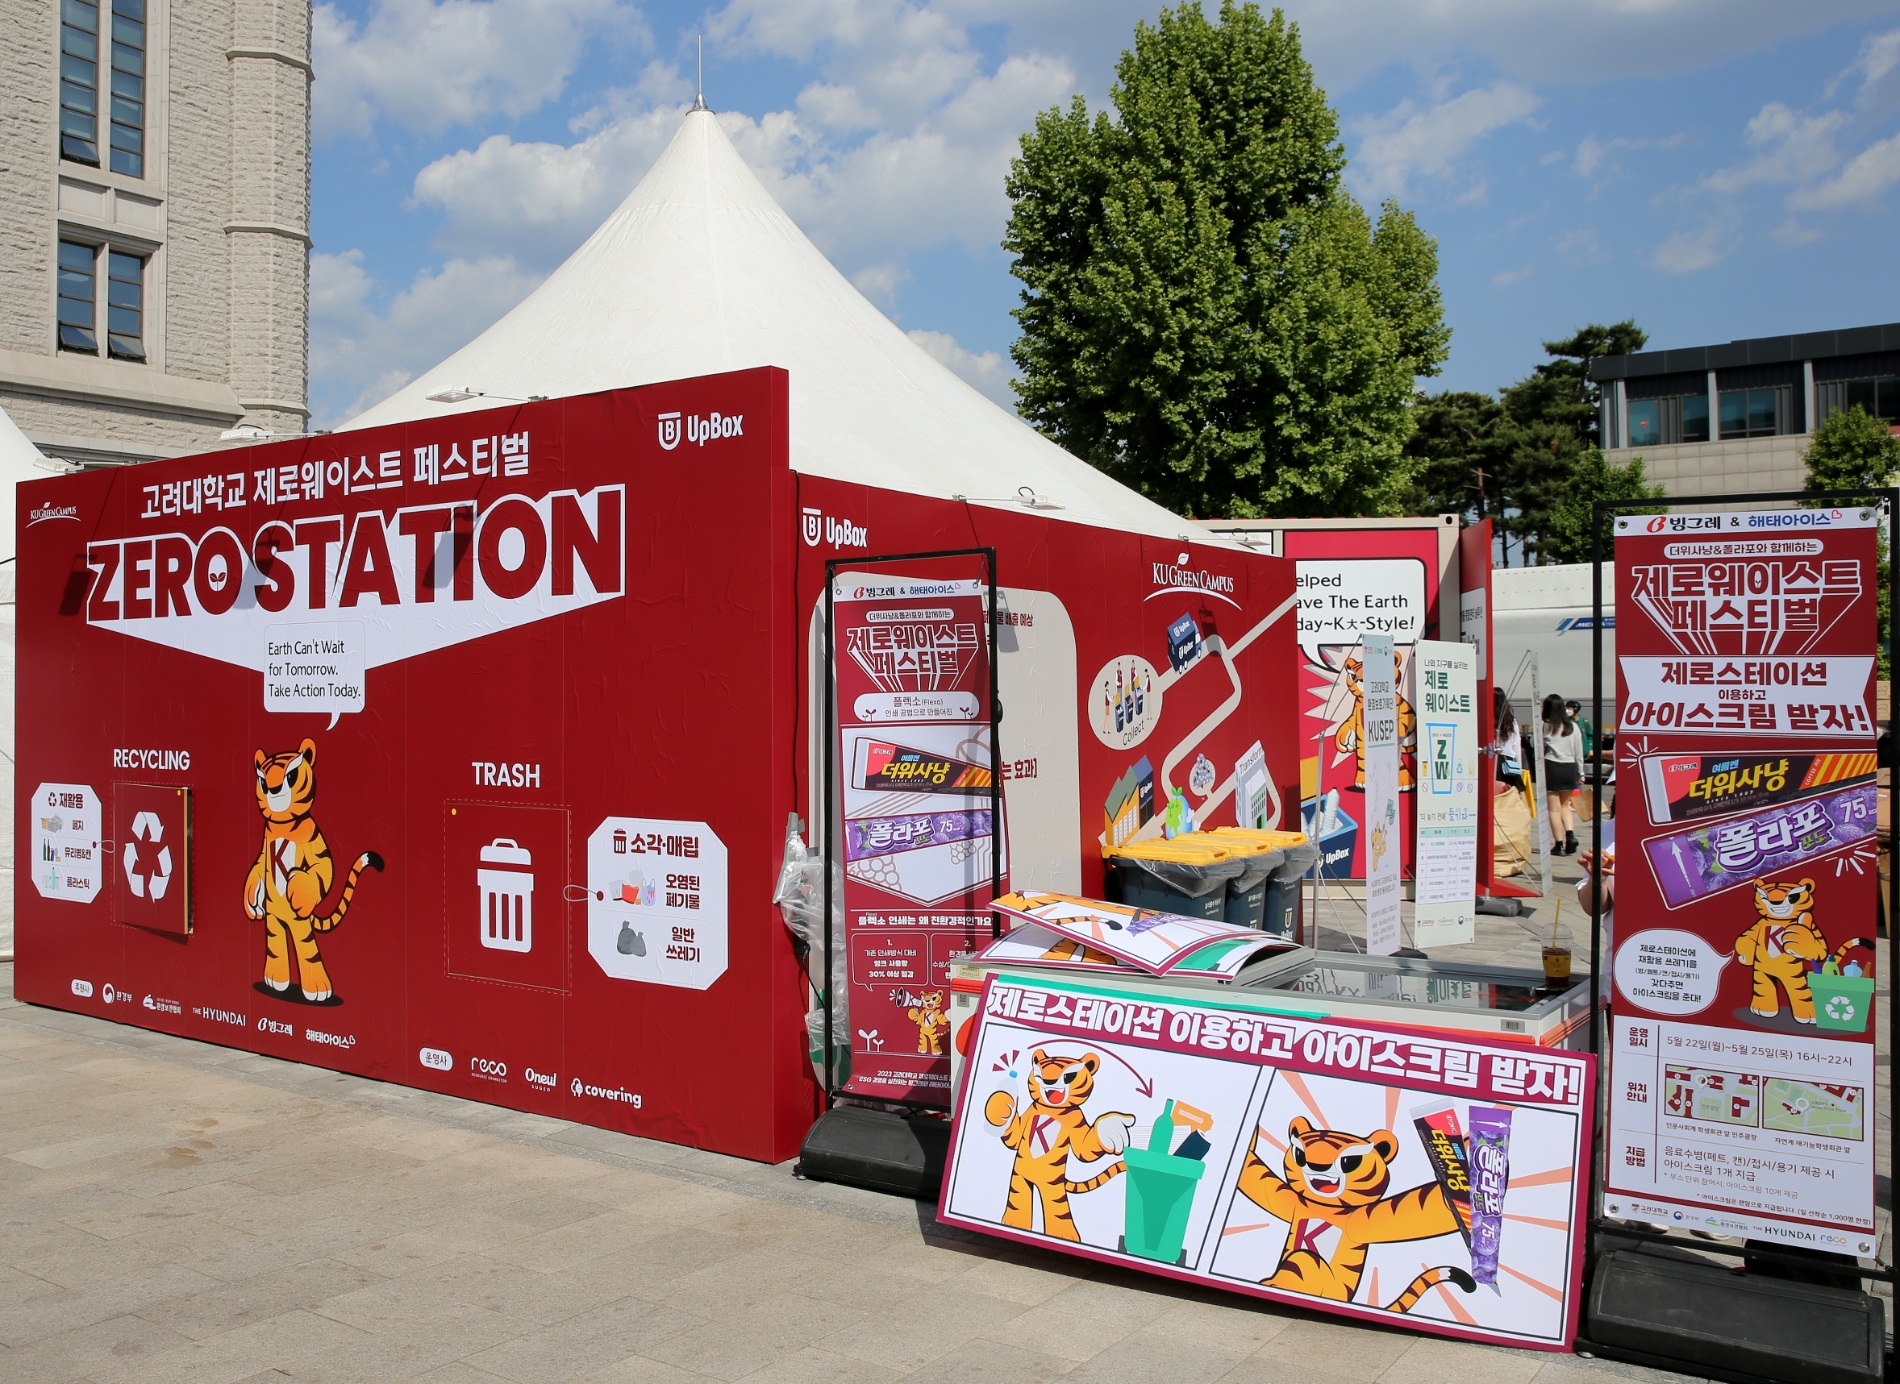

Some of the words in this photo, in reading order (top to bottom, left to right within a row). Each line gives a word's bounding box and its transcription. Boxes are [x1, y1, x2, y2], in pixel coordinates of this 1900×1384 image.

[687, 411, 744, 447] UpBox
[141, 473, 246, 519] 고려대학교
[253, 451, 403, 506] 제로웨이스트
[413, 431, 529, 486] 페스티벌
[1670, 516, 1721, 531] 빙그레
[1730, 517, 1740, 527] &
[1748, 513, 1831, 528] 해태아이스
[825, 516, 868, 550] UpBox
[87, 530, 243, 621] ZERO
[253, 488, 621, 613] STATION
[1669, 543, 1767, 556] 더위사냥&폴라포와
[1770, 542, 1818, 553] 함께하는
[1152, 562, 1168, 585] KU
[1200, 570, 1234, 593] CAMPUS
[1632, 560, 1862, 598] 제로웨이스트
[866, 586, 895, 598] 빙그레
[900, 587, 906, 595] &
[909, 585, 955, 596] 해태아이스
[1328, 595, 1359, 609] The
[1365, 594, 1408, 609] Earth
[1671, 598, 1819, 632] 페스티벌
[847, 623, 979, 652] 제로웨이스트
[268, 641, 293, 656] Earth
[294, 639, 319, 655] Can't
[321, 640, 345, 655] Wait
[268, 662, 283, 677] for
[285, 663, 339, 677] Tomorrow.
[874, 651, 959, 675] 페스티벌
[1425, 670, 1448, 690] 제로
[1661, 661, 1827, 686] 제로스테이션
[268, 683, 291, 698] Take
[293, 683, 326, 698] Action
[328, 684, 361, 700] Today.
[1718, 690, 1766, 700] 이용하고
[1425, 693, 1471, 713] 웨이스트
[1625, 702, 1776, 729] 아이스크림
[1787, 703, 1868, 731] 받자!
[1123, 719, 1145, 746] Collect
[1368, 720, 1394, 742] KUSEP
[1437, 740, 1446, 759] Z
[113, 748, 190, 771] RECYCLING
[1711, 759, 1739, 774] 여름엔
[472, 762, 541, 788] TRASH
[881, 761, 951, 784] 더위사냥
[1435, 761, 1449, 780] W
[1688, 758, 1789, 800] 더위사냥
[59, 792, 84, 810] 재활용
[1840, 797, 1867, 824] 75
[869, 818, 932, 847] 폴라포
[940, 820, 953, 833] 75
[1718, 803, 1827, 867] 폴라포
[631, 833, 699, 858] 소각·매립
[1801, 829, 1830, 850] 포도
[1325, 848, 1350, 865] UpBox
[66, 876, 90, 890] 플라스틱
[666, 874, 700, 891] 오염된
[666, 892, 700, 910] 폐기물
[888, 916, 916, 926] 인쇄는
[918, 916, 928, 926] 왜
[931, 916, 993, 926] 친환경적인가요
[671, 926, 695, 943] 일반
[666, 945, 700, 963] 쓰레기
[1640, 944, 1696, 956] 제로스테이션에
[1638, 956, 1662, 965] 재활용
[1665, 958, 1697, 968] 쓰레기를
[1651, 978, 1683, 990] 갖다주면
[116, 991, 132, 1003] 환경부
[1633, 988, 1680, 1001] 아이스크림을
[1682, 992, 1702, 1003] 준대!
[192, 1007, 201, 1015] THE
[202, 1007, 246, 1026] HYUNDAI
[268, 1019, 293, 1037] 빙그레
[1629, 1027, 1649, 1038] 운영
[305, 1028, 350, 1049] 해태아이스
[988, 986, 1165, 1041] 제로스테이션
[1169, 1011, 1294, 1060] 이용하고
[1303, 1029, 1479, 1089] 아이스크림
[1490, 1055, 1580, 1104] 받자!
[1629, 1037, 1648, 1048] 일시
[425, 1052, 447, 1067] 운영사
[1667, 1037, 1683, 1047] 5월
[1685, 1038, 1748, 1055] 22일(월)~5월
[1751, 1046, 1793, 1060] 25일(목)
[1797, 1052, 1852, 1066] 16시~22시
[471, 1056, 507, 1077] reco
[525, 1067, 557, 1087] Oneul
[585, 1084, 642, 1109] covering
[1627, 1082, 1647, 1093] 위치
[1626, 1092, 1648, 1103] 안내
[1431, 1129, 1470, 1192] 더위사냥
[1626, 1146, 1645, 1156] 지급
[1626, 1156, 1645, 1167] 방법
[1664, 1145, 1730, 1164] 음료수병(페트,
[1800, 1164, 1822, 1178] 제공
[1825, 1167, 1835, 1179] 시
[1664, 1159, 1713, 1175] 아이스크림
[1717, 1166, 1735, 1178] 1개
[1737, 1168, 1756, 1182] 지급
[1478, 1145, 1505, 1214] 폴라포
[1726, 1179, 1762, 1194] 아이스크림
[1765, 1186, 1782, 1196] 10개
[1784, 1189, 1799, 1199] 제공
[1641, 1205, 1669, 1215] 고려대학교
[1828, 1212, 1854, 1224] 1,000명
[1482, 1222, 1495, 1239] 75
[1764, 1226, 1816, 1242] HYUNDAI
[1820, 1234, 1847, 1244] reco
